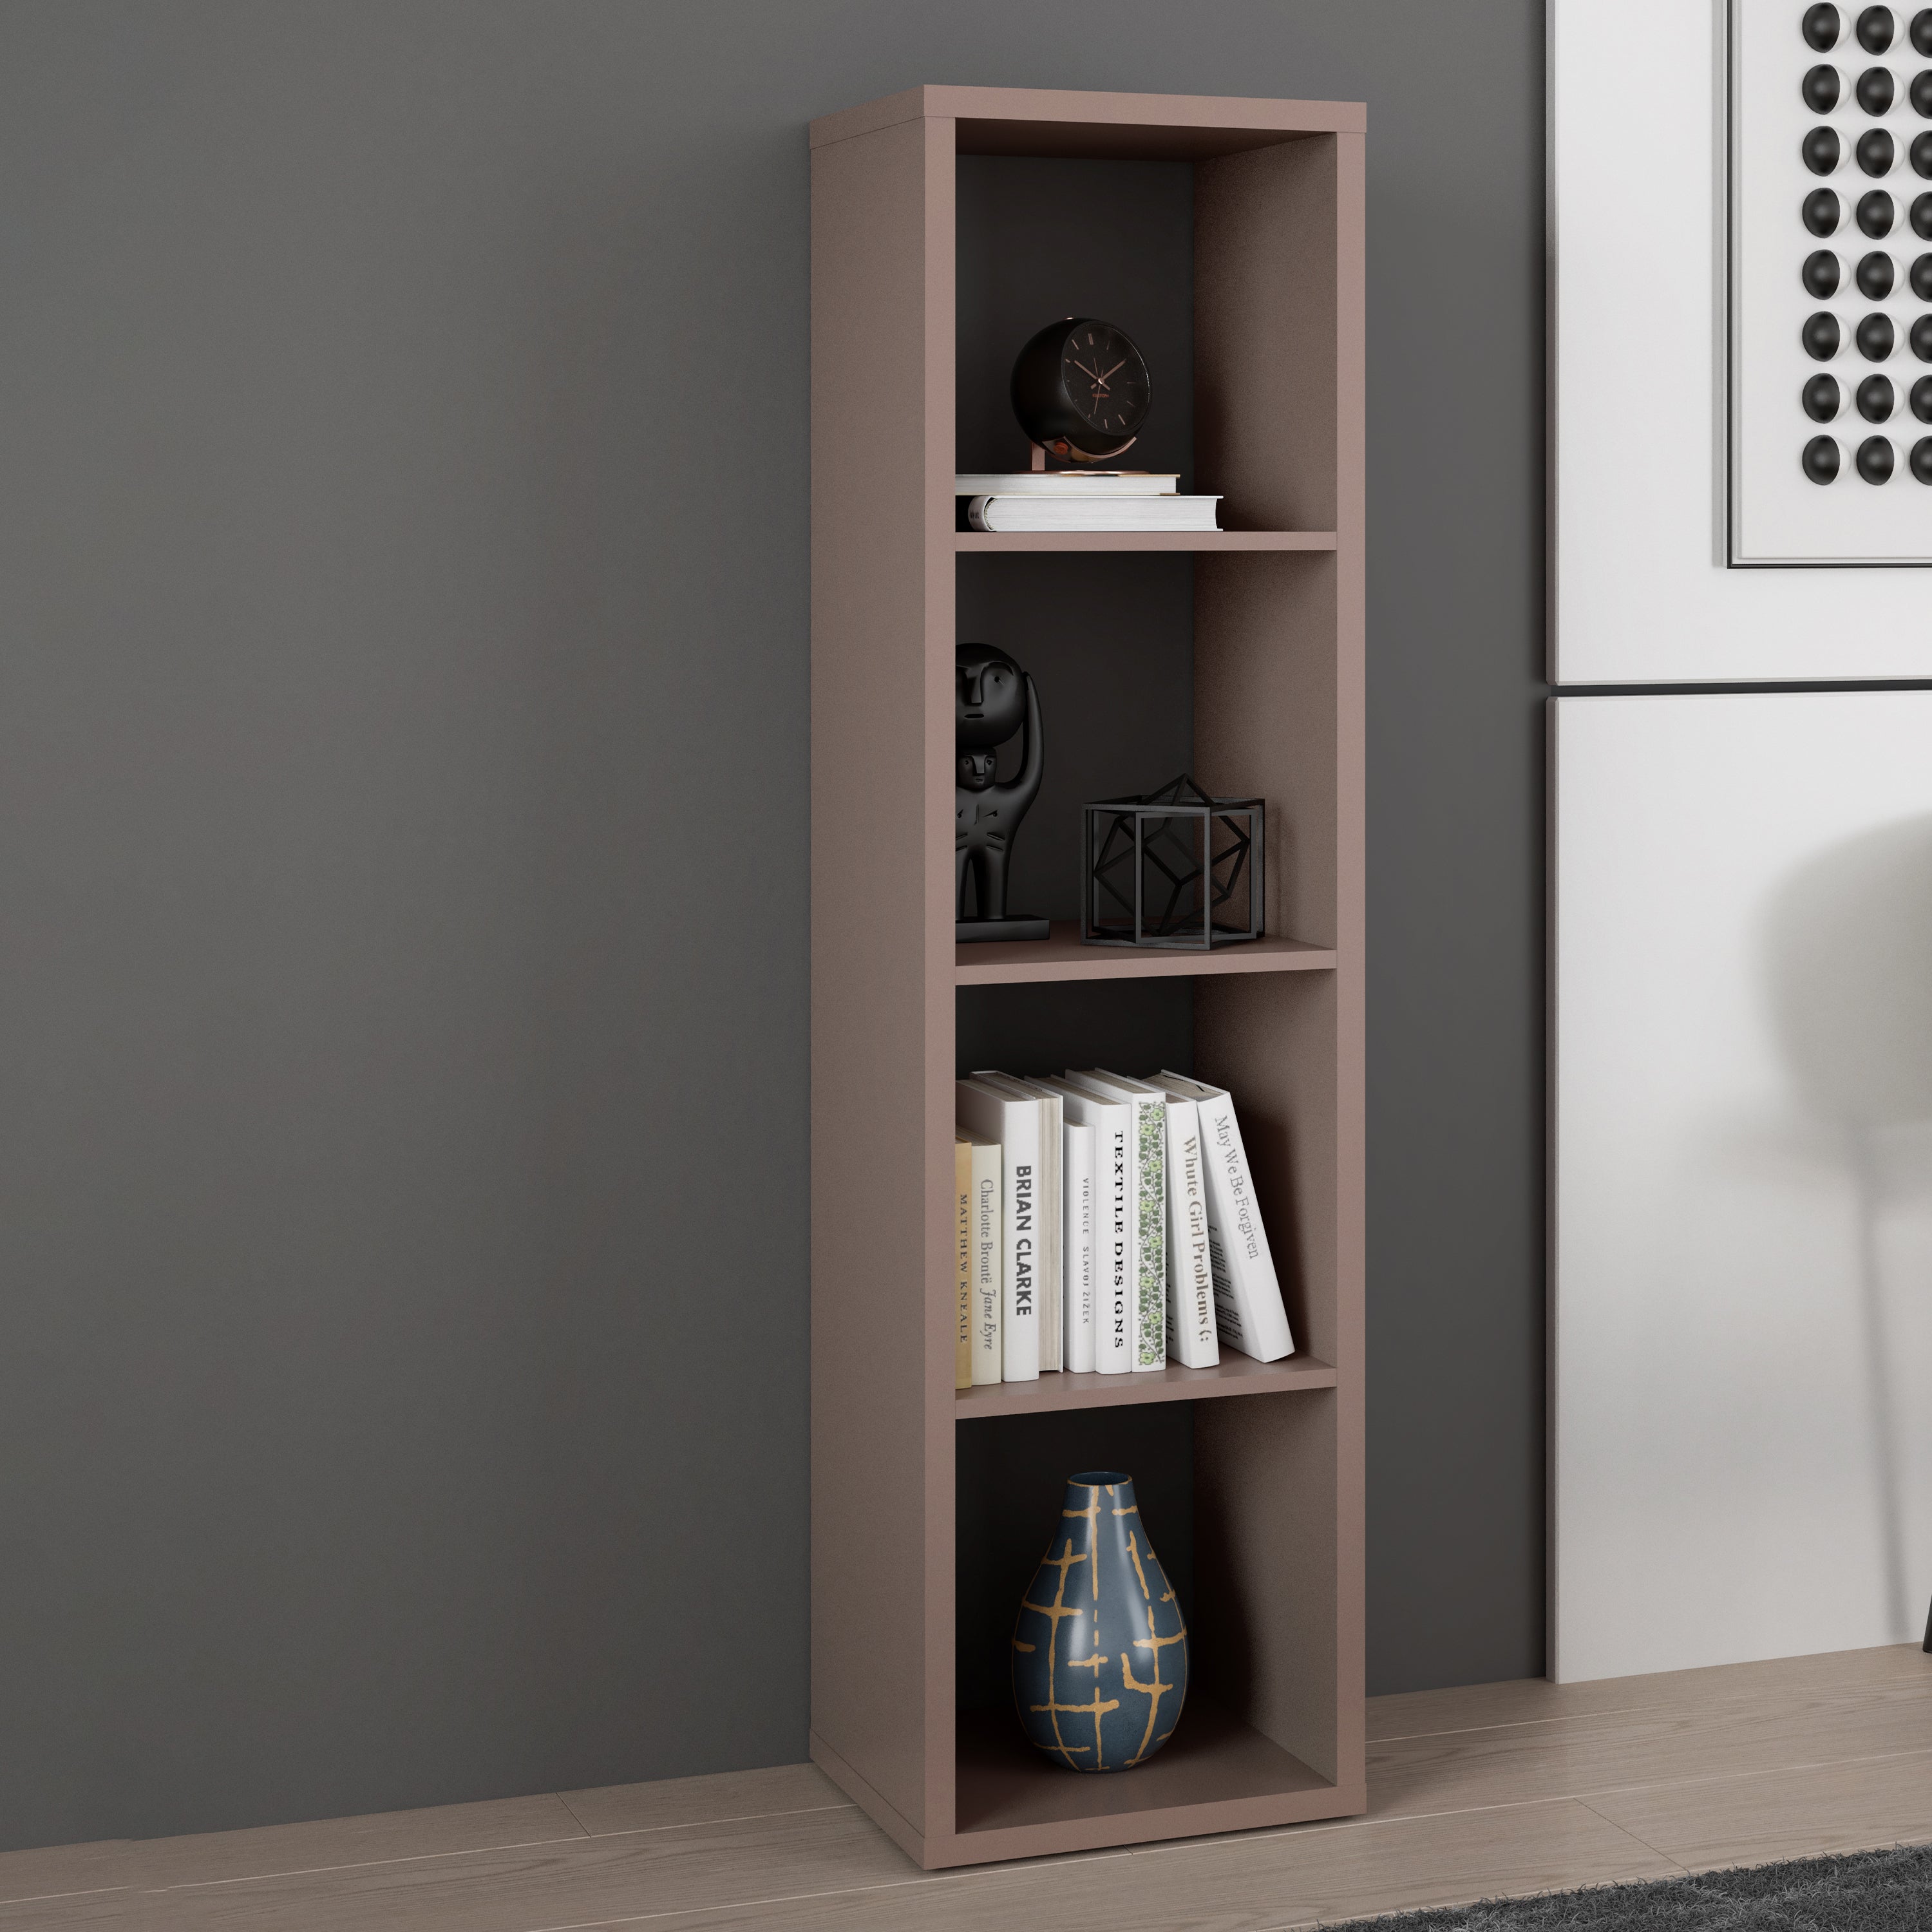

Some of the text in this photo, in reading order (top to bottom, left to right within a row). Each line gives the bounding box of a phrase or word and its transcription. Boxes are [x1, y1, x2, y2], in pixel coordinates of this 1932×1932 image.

[981, 1179, 994, 1238] Charlotte
[1189, 1200, 1204, 1237] Girl
[1215, 1115, 1258, 1260] May We Be Forgiven
[1016, 1166, 1032, 1316] BRIAN CLARKE
[1114, 1130, 1123, 1348] TEXTILE DESIGNS
[980, 1288, 996, 1319] Jane
[1193, 1240, 1209, 1325] Problems
[980, 1322, 996, 1350] Eyre
